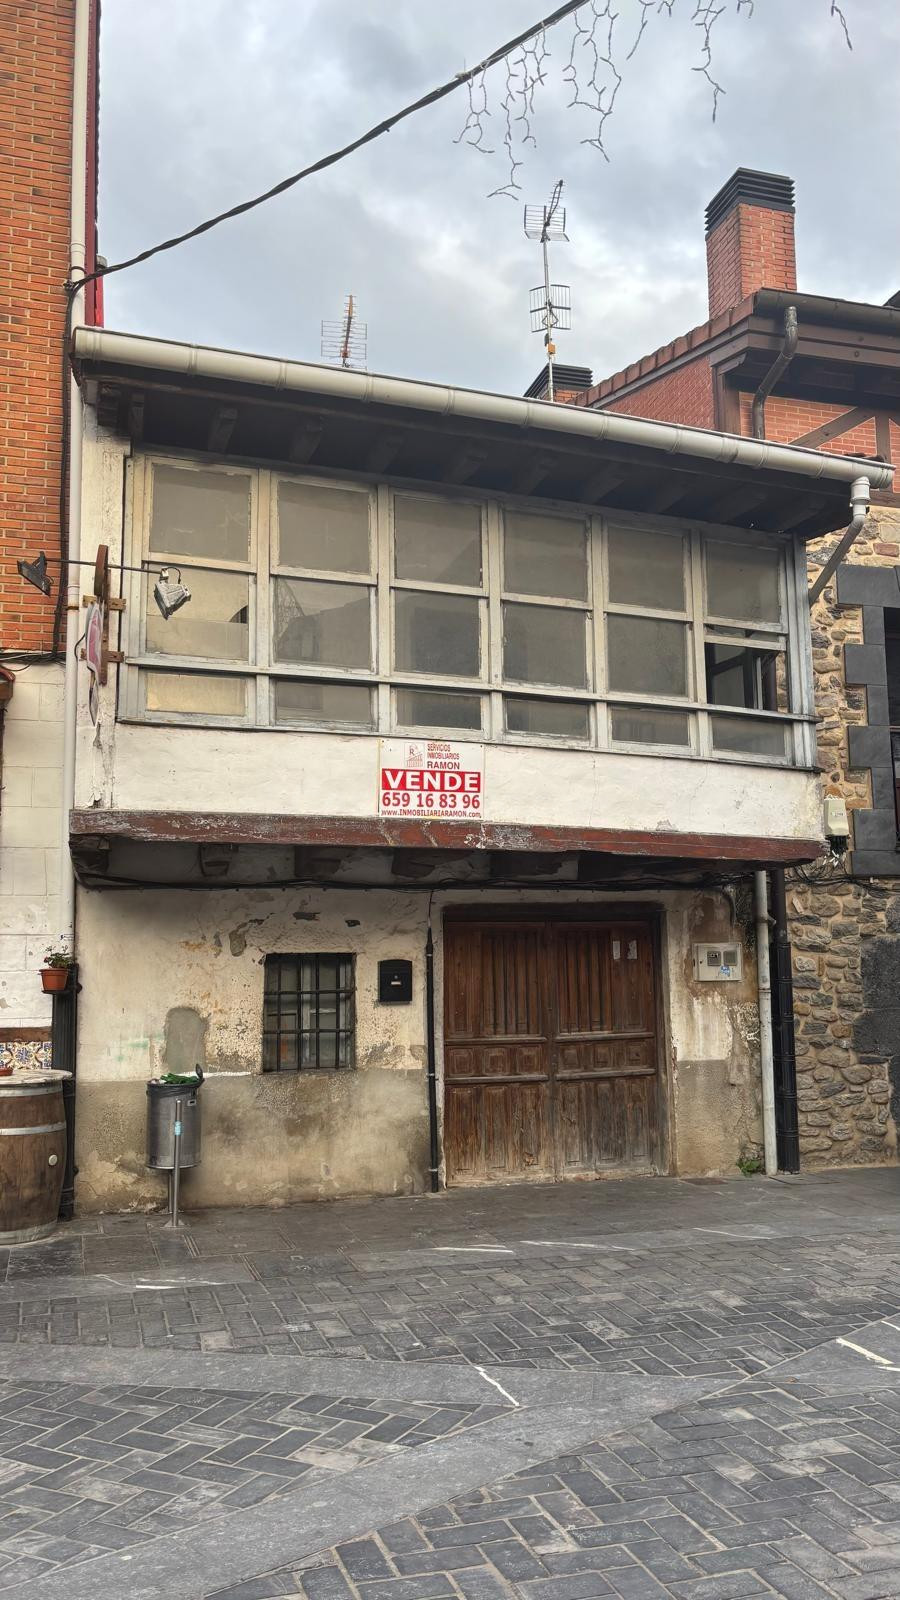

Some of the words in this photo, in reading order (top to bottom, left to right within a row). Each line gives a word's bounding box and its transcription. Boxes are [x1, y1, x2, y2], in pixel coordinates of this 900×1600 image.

[427, 744, 450, 752] SERVICIOS
[426, 761, 460, 770] RAMON
[384, 770, 478, 792] VENDE
[382, 792, 410, 807] 659
[416, 793, 434, 808] 16
[439, 794, 457, 808] 83
[462, 794, 480, 809] 96
